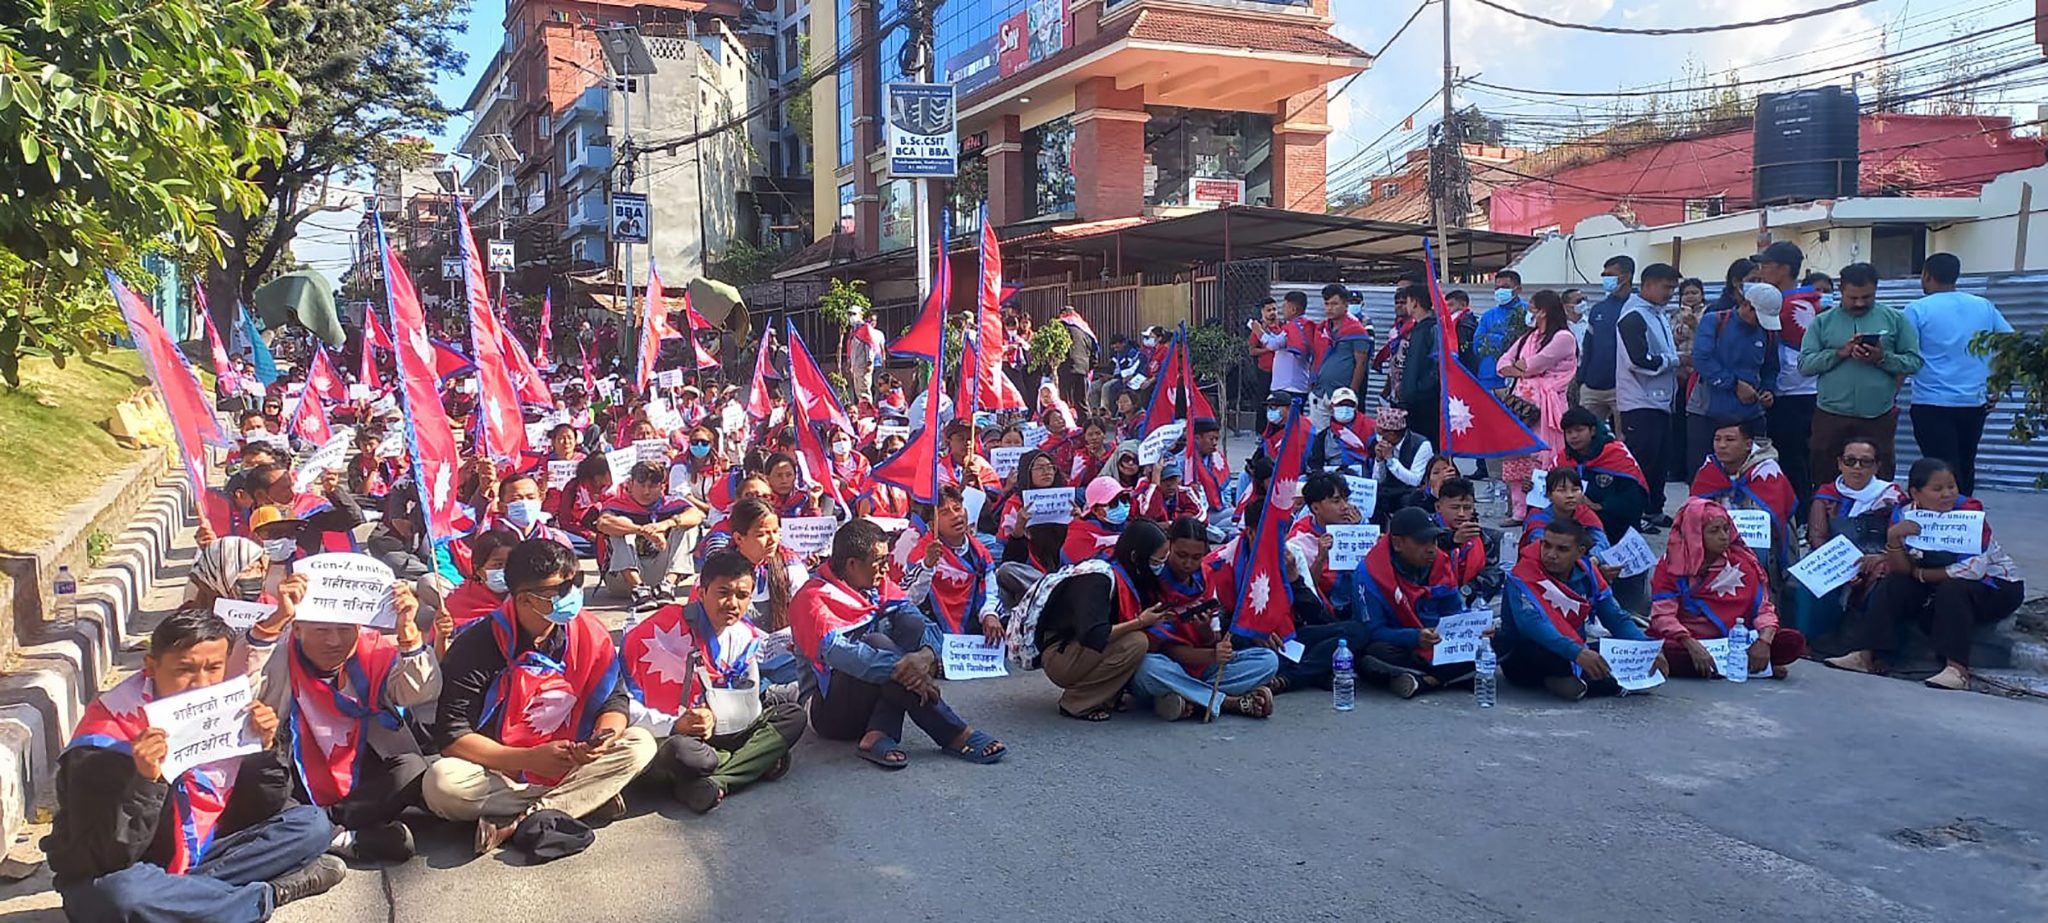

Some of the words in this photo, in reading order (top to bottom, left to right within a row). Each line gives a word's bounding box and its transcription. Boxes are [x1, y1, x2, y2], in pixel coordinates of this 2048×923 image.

[895, 147, 917, 156] BCA
[928, 148, 950, 156] BBA
[615, 206, 643, 218] BBA
[492, 247, 511, 256] BCA
[1915, 511, 1945, 519] Gen-Z
[310, 560, 353, 571] Gen-Z
[312, 596, 338, 609] रगत
[949, 640, 973, 650] Gen-Z
[1611, 646, 1638, 655] Gen-Z
